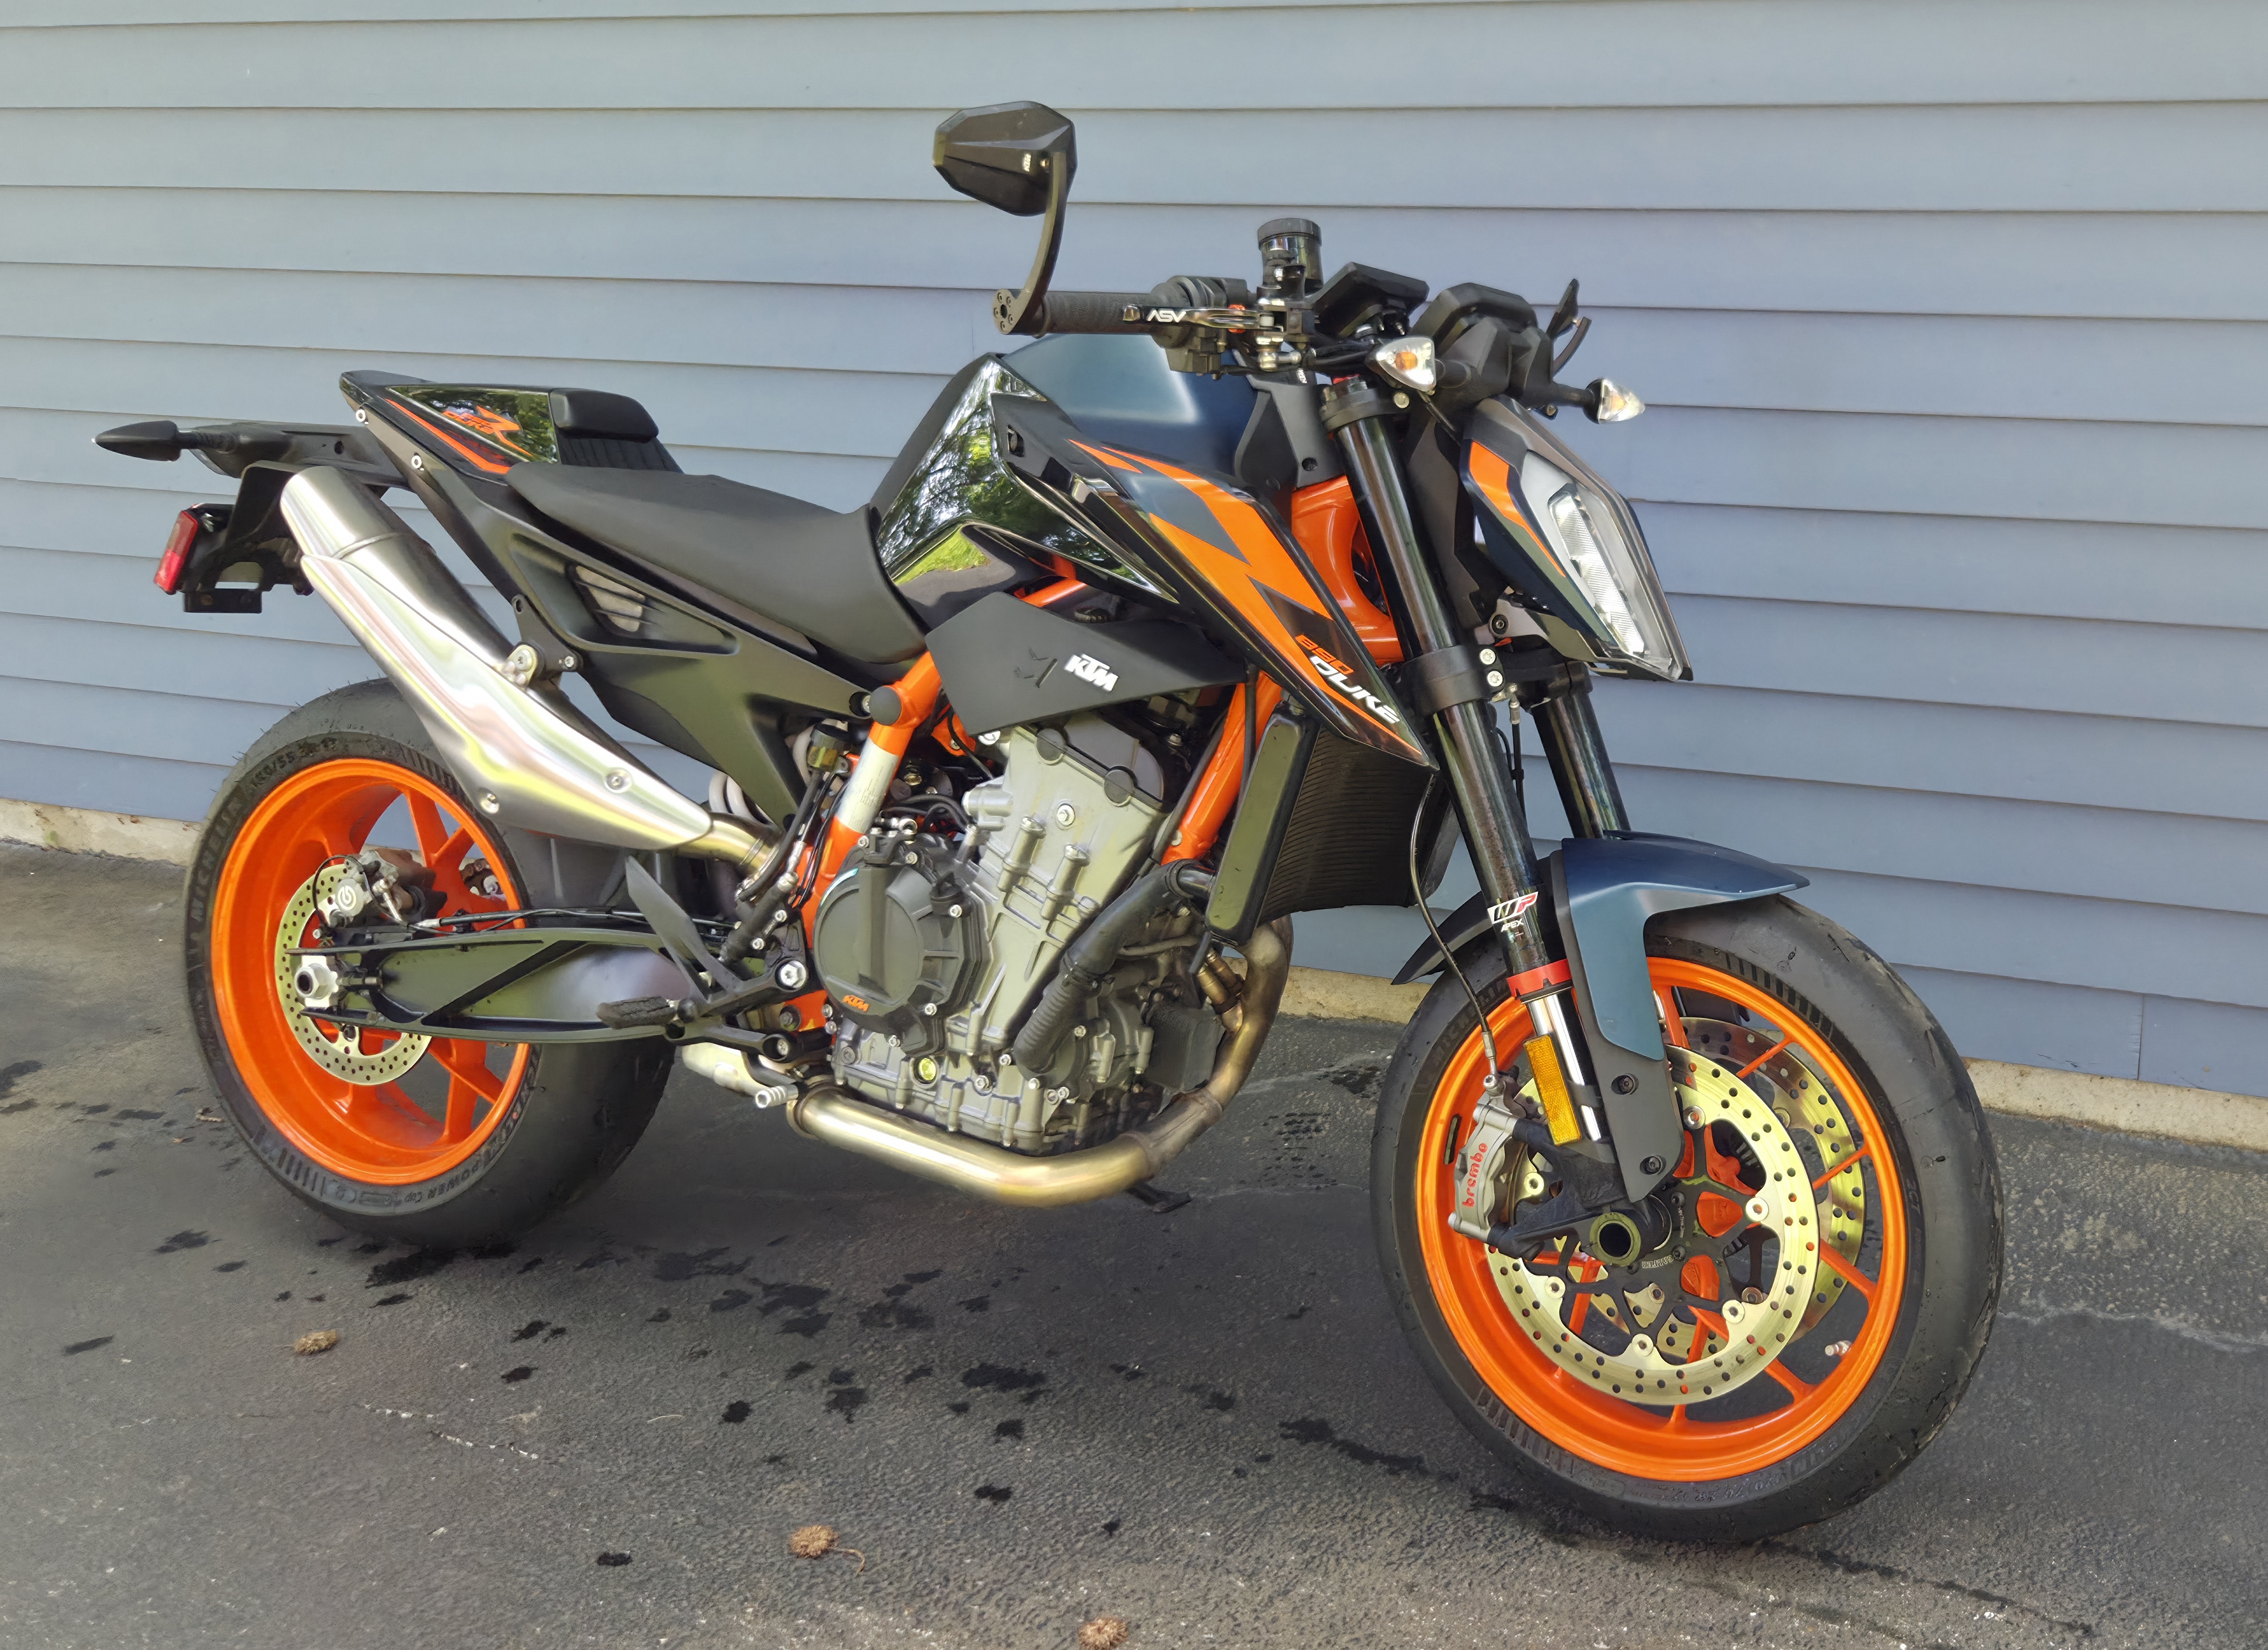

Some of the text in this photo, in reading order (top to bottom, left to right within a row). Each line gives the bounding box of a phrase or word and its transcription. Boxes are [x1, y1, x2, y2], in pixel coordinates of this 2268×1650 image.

[1146, 310, 1187, 323] ASV
[1064, 654, 1119, 692] KTM
[1296, 635, 1354, 675] 890
[1310, 656, 1400, 723] DUKE
[1500, 918, 1525, 932] APEX
[843, 994, 869, 1012] KTM
[1462, 1142, 1488, 1208] brembo
